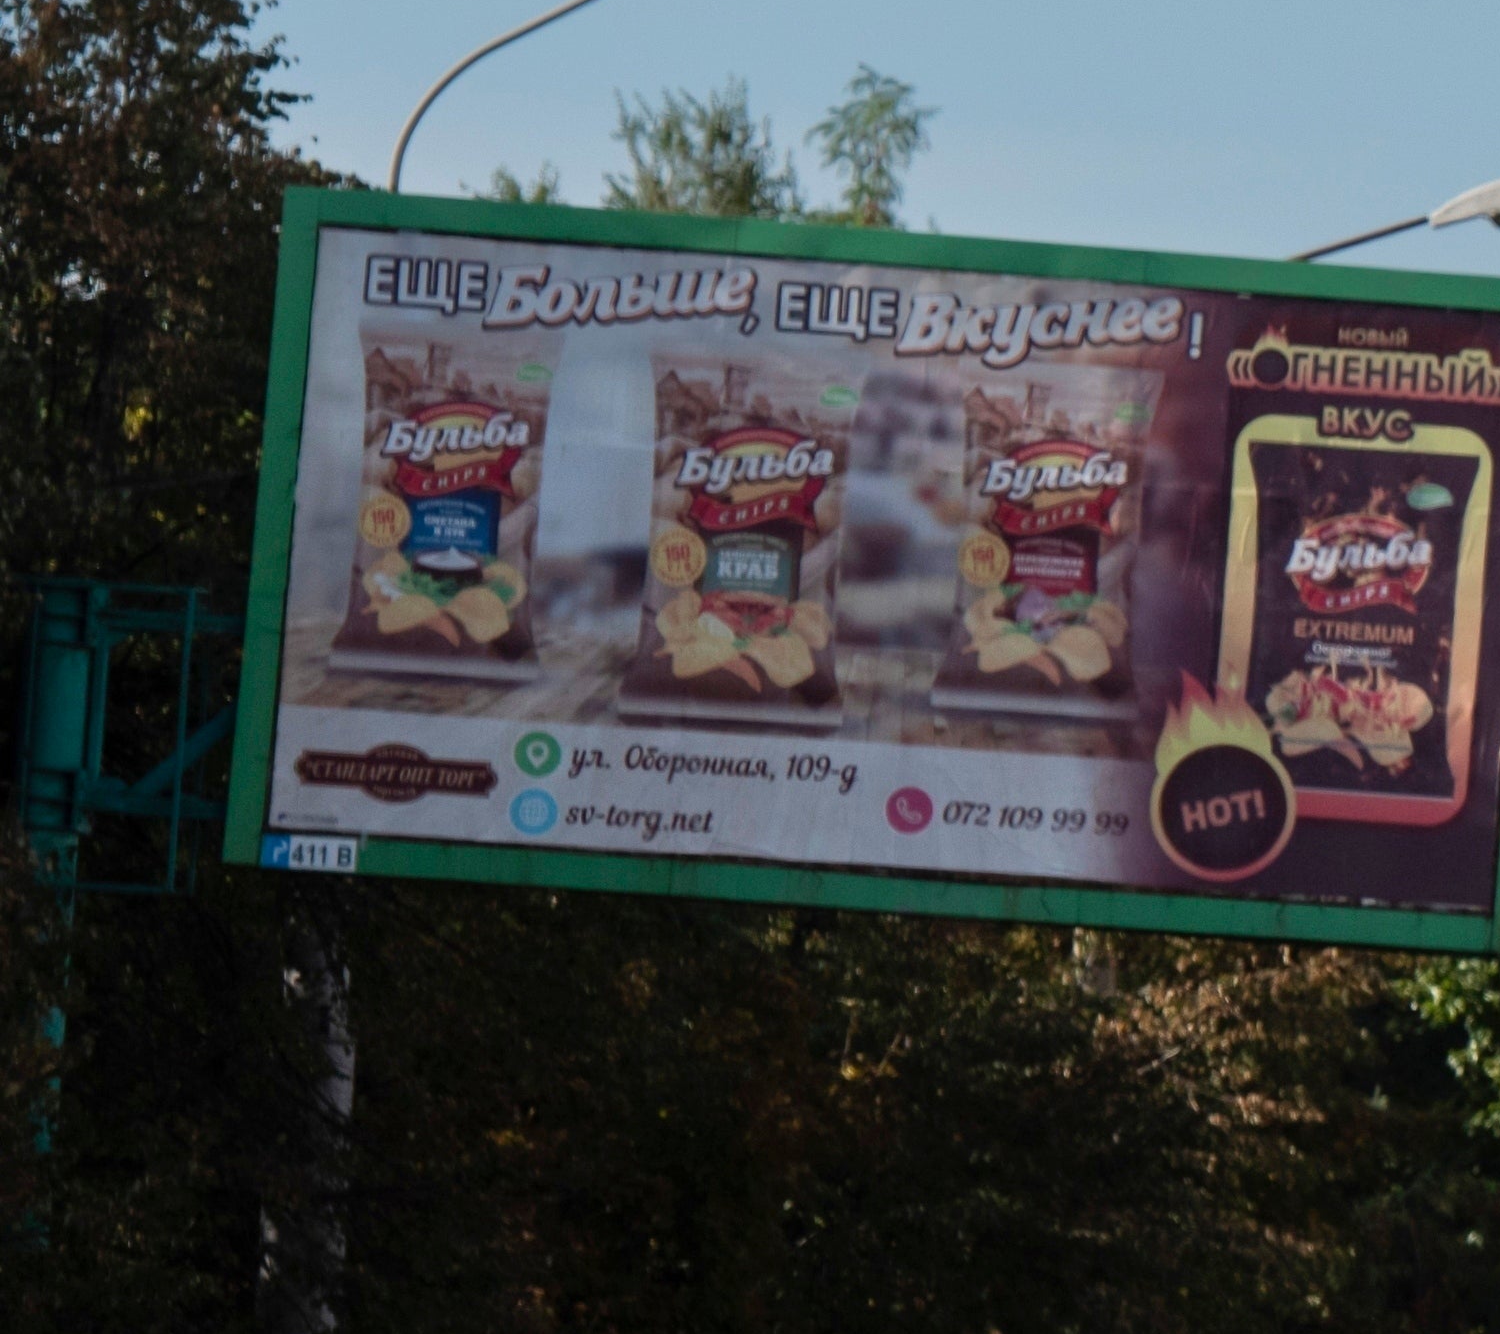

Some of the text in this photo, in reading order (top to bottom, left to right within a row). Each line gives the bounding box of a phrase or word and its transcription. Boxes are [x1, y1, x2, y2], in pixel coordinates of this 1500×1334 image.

[365, 255, 487, 315] ЕЩЕ
[483, 264, 760, 335] Больше,
[776, 281, 898, 341] ЕЩЕ
[1338, 327, 1409, 346] НОВЫЙ
[381, 412, 530, 462] Бульба
[1321, 405, 1412, 438] ВКУС
[422, 467, 486, 491] CHIPS
[675, 440, 834, 494] Бульба
[981, 452, 1127, 500] Бульба
[718, 498, 789, 525] CHIPS
[1285, 532, 1432, 581] Бульба
[1293, 618, 1414, 645] EXTREMUM
[569, 748, 610, 778] ул.
[624, 745, 776, 783] Оборонная,
[565, 804, 713, 841] sv-torg.net
[942, 801, 1129, 836] 072 109 99 99
[1181, 789, 1266, 833] HOT!
[292, 843, 328, 866] 411
